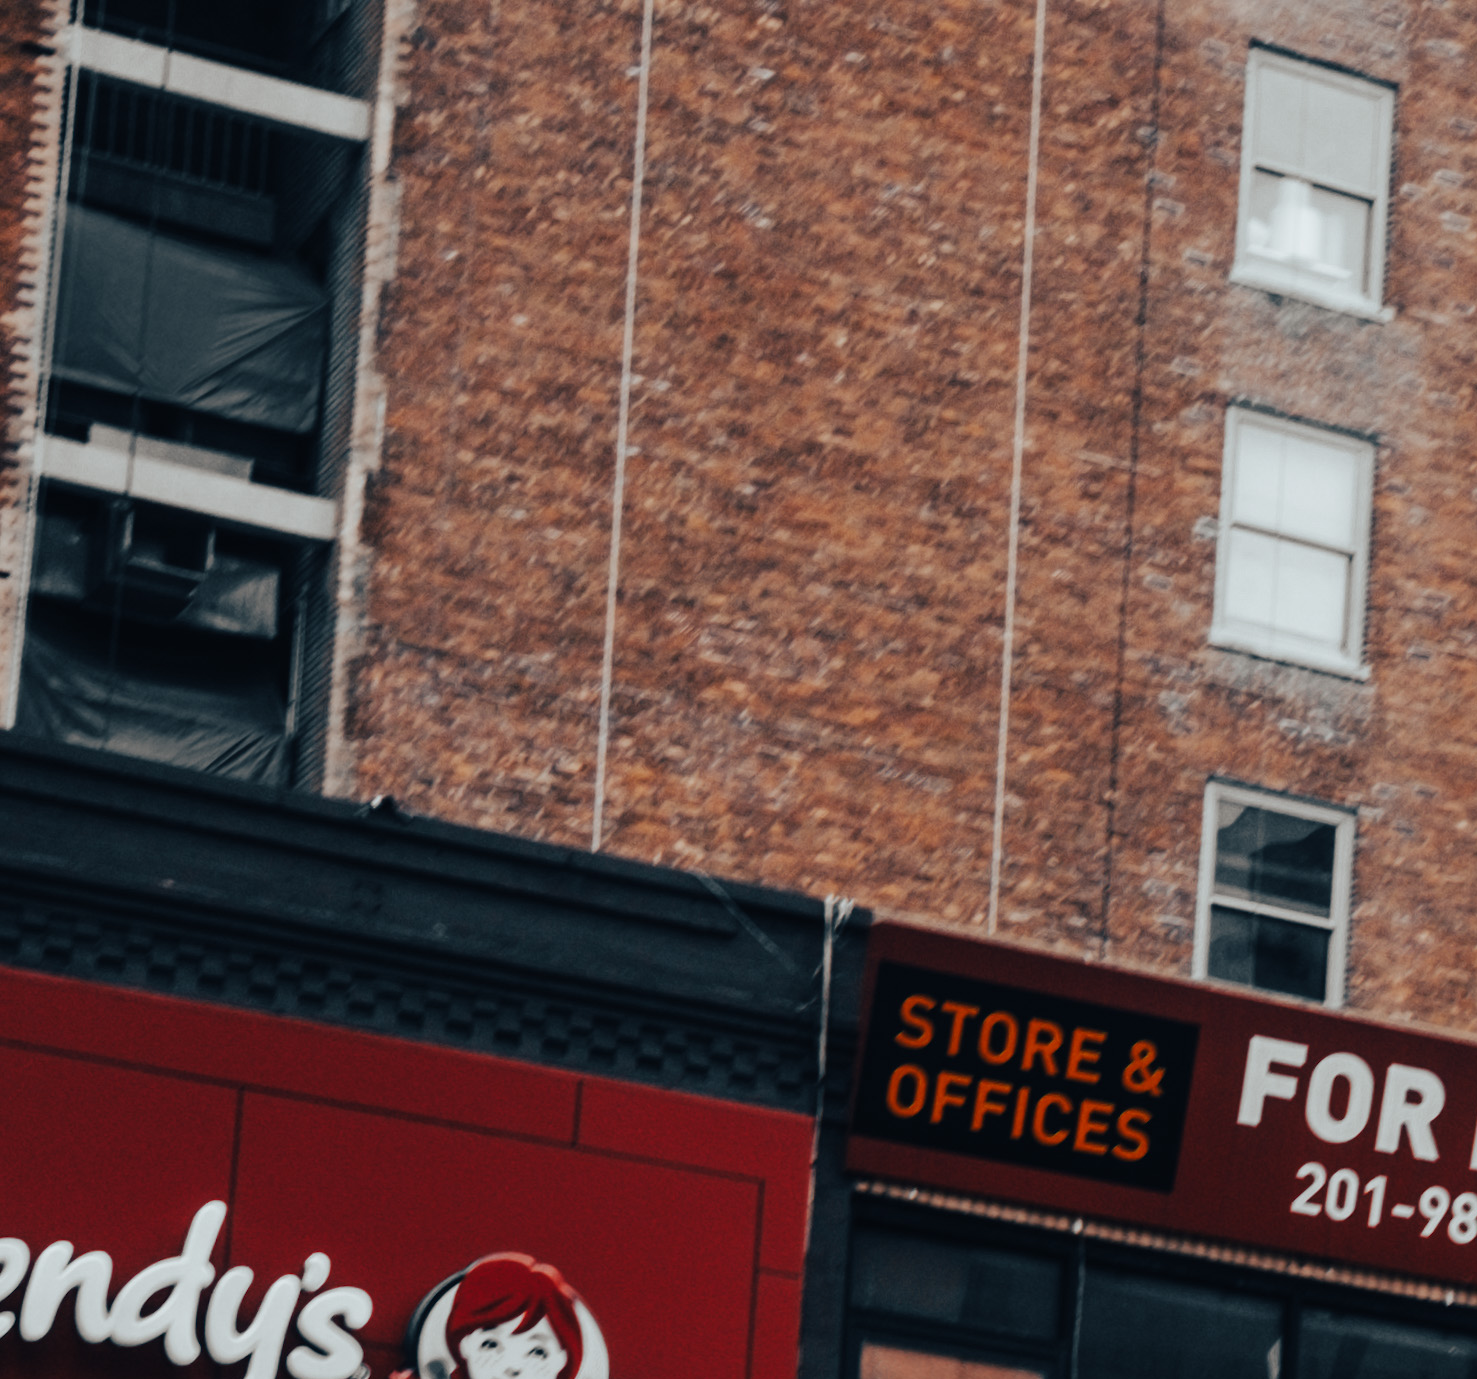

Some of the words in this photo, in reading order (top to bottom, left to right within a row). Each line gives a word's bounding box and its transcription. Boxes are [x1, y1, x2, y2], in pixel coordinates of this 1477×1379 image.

[896, 993, 1104, 1083] STORE
[1121, 1038, 1165, 1098] &
[1236, 1034, 1447, 1162] FOR
[886, 1063, 1152, 1164] OFFICES
